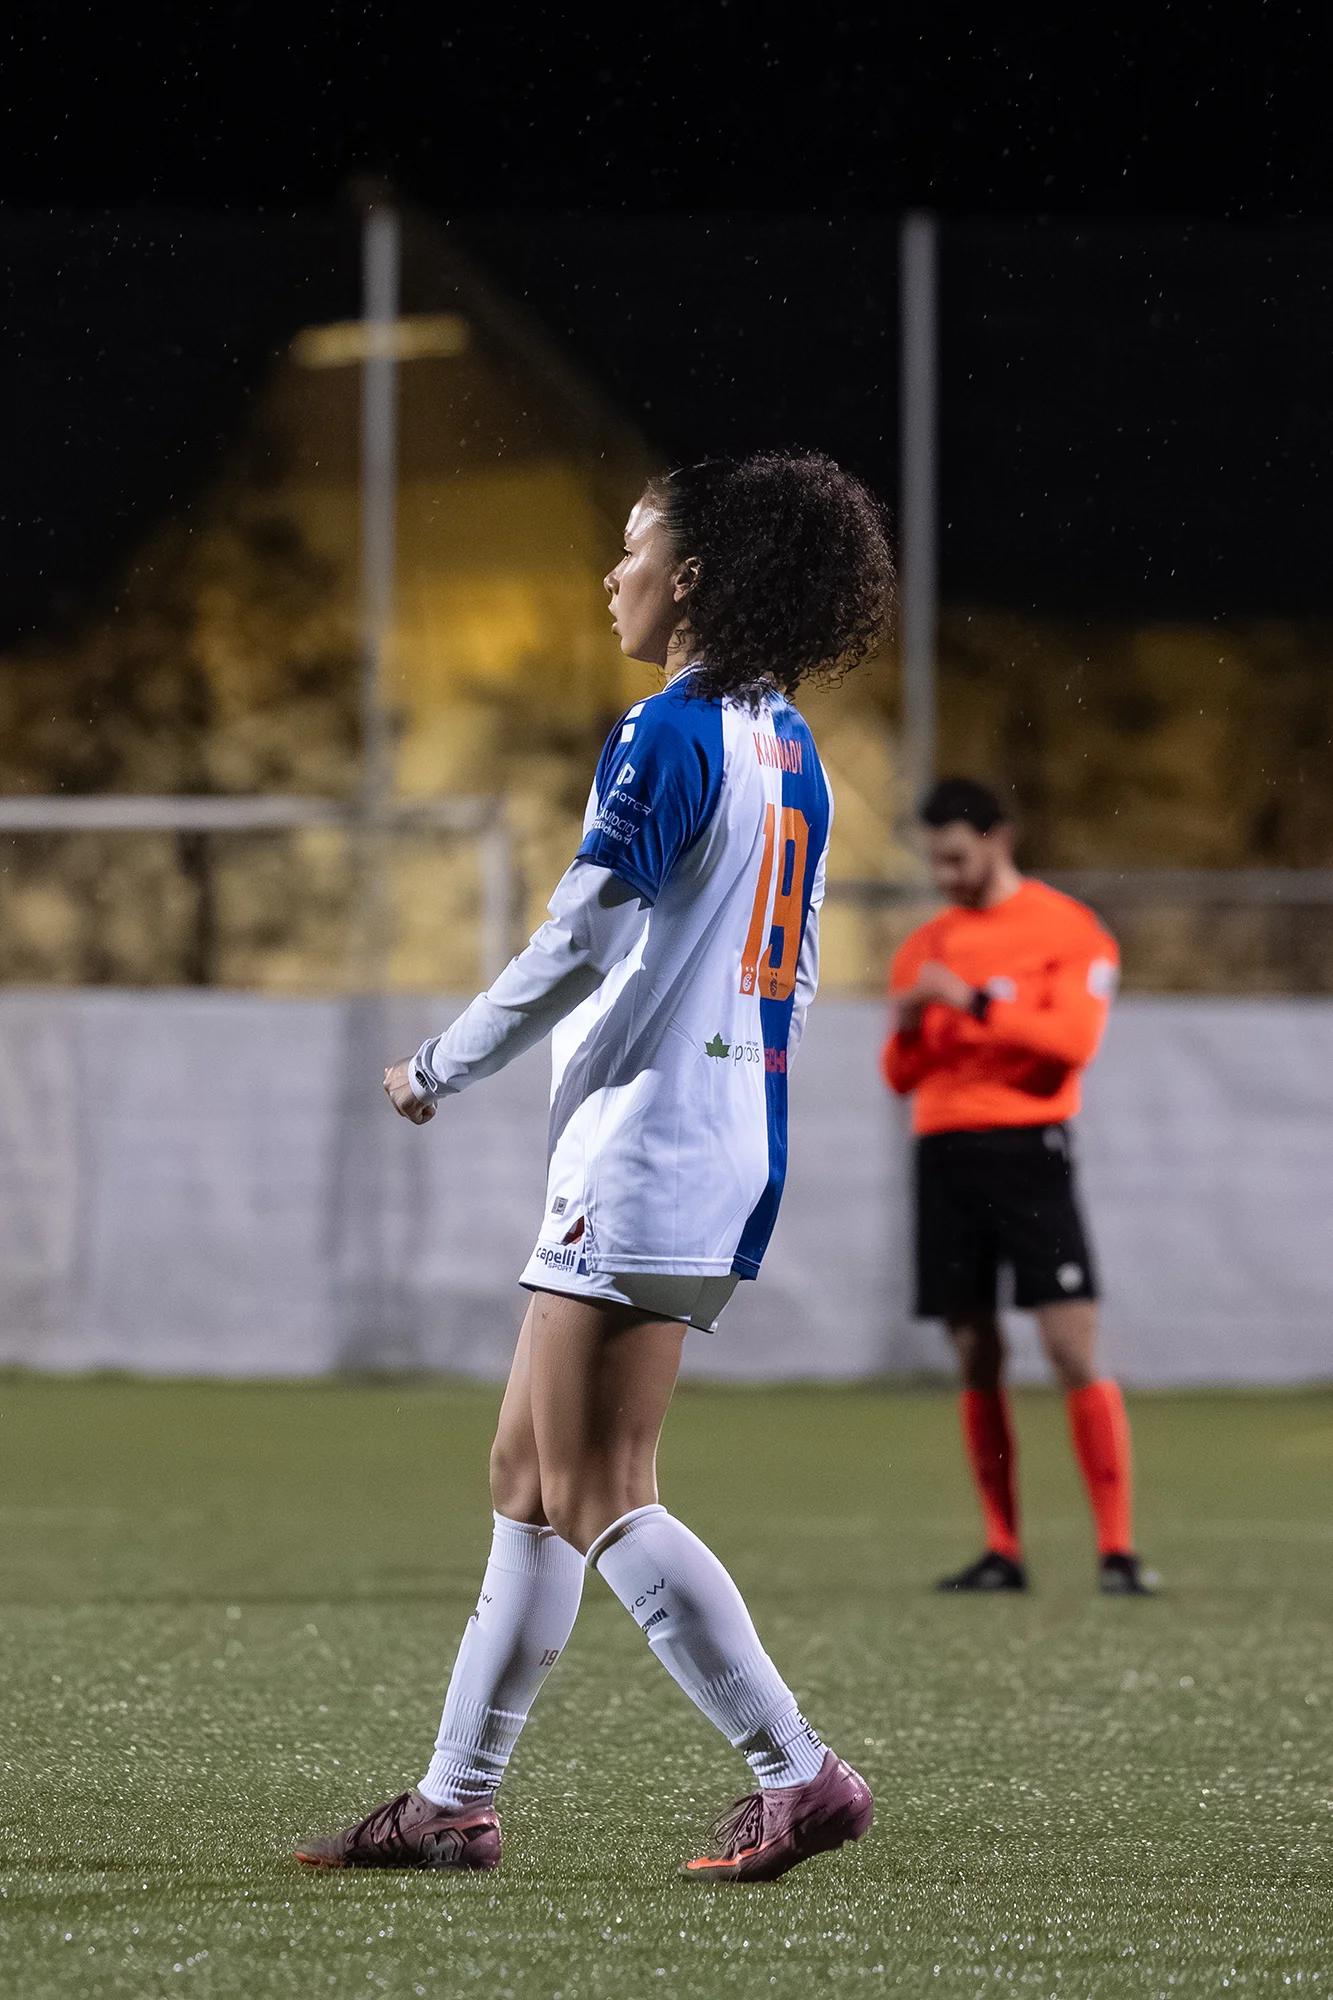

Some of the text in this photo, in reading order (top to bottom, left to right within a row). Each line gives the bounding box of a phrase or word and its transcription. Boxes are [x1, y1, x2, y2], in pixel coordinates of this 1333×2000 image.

[738, 803, 810, 1000] 19
[536, 1247, 577, 1267] capelli
[539, 1649, 559, 1666] 19
